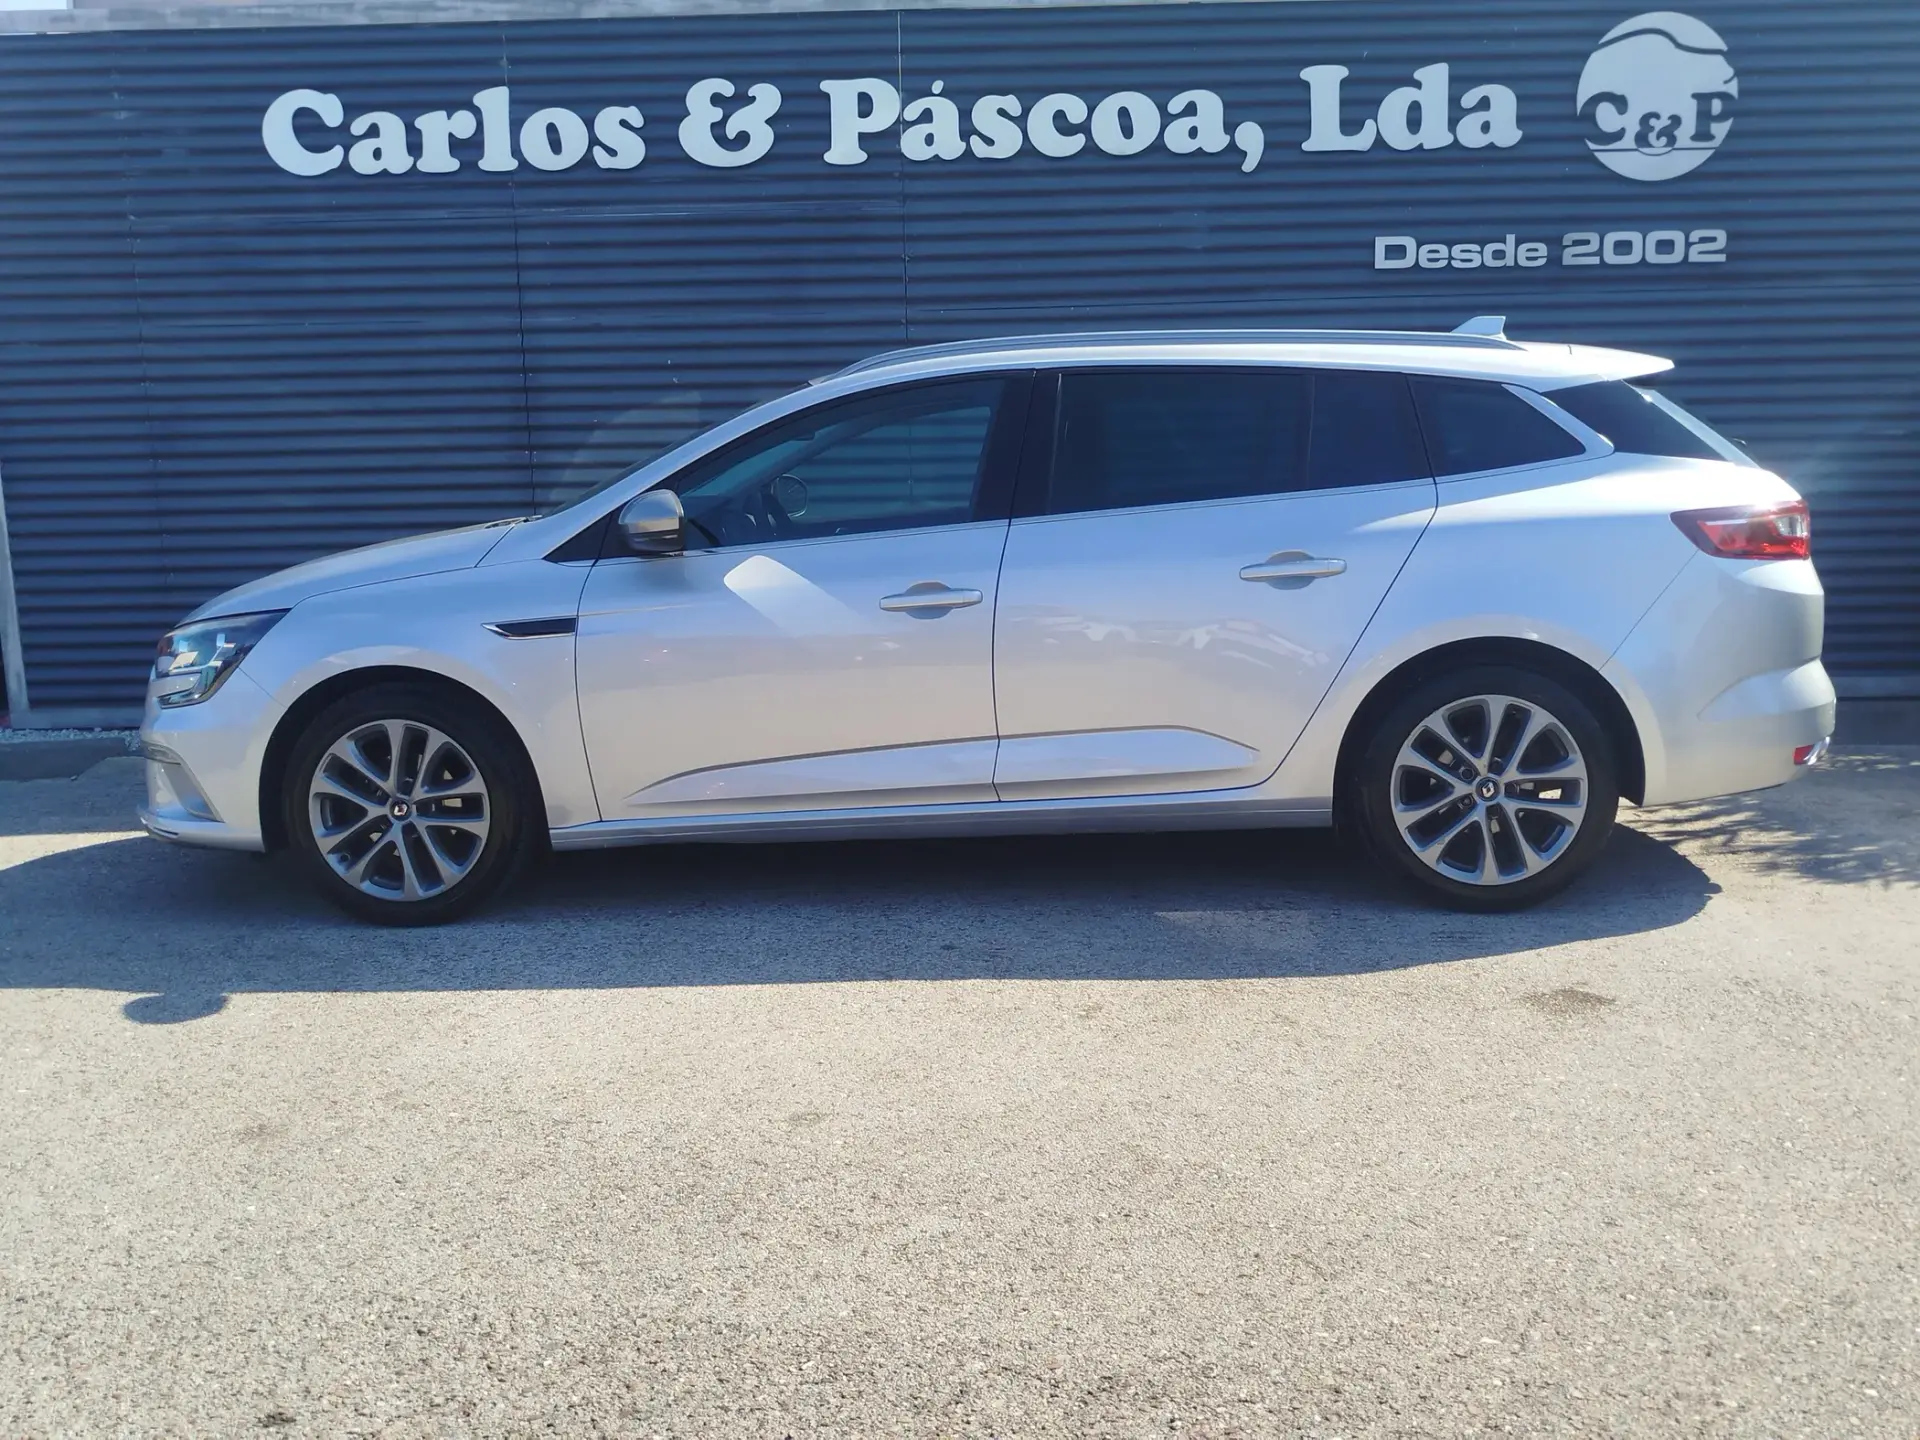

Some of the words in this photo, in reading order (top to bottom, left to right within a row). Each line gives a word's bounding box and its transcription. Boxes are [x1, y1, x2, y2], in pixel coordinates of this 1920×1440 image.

[261, 86, 647, 177] Carlos
[677, 77, 783, 168] &
[819, 77, 1265, 174] Páscoa,
[1299, 62, 1524, 152] Lda
[1579, 91, 1737, 155] C&P
[1373, 233, 1548, 270] Desde
[1561, 228, 1728, 266] 2002
